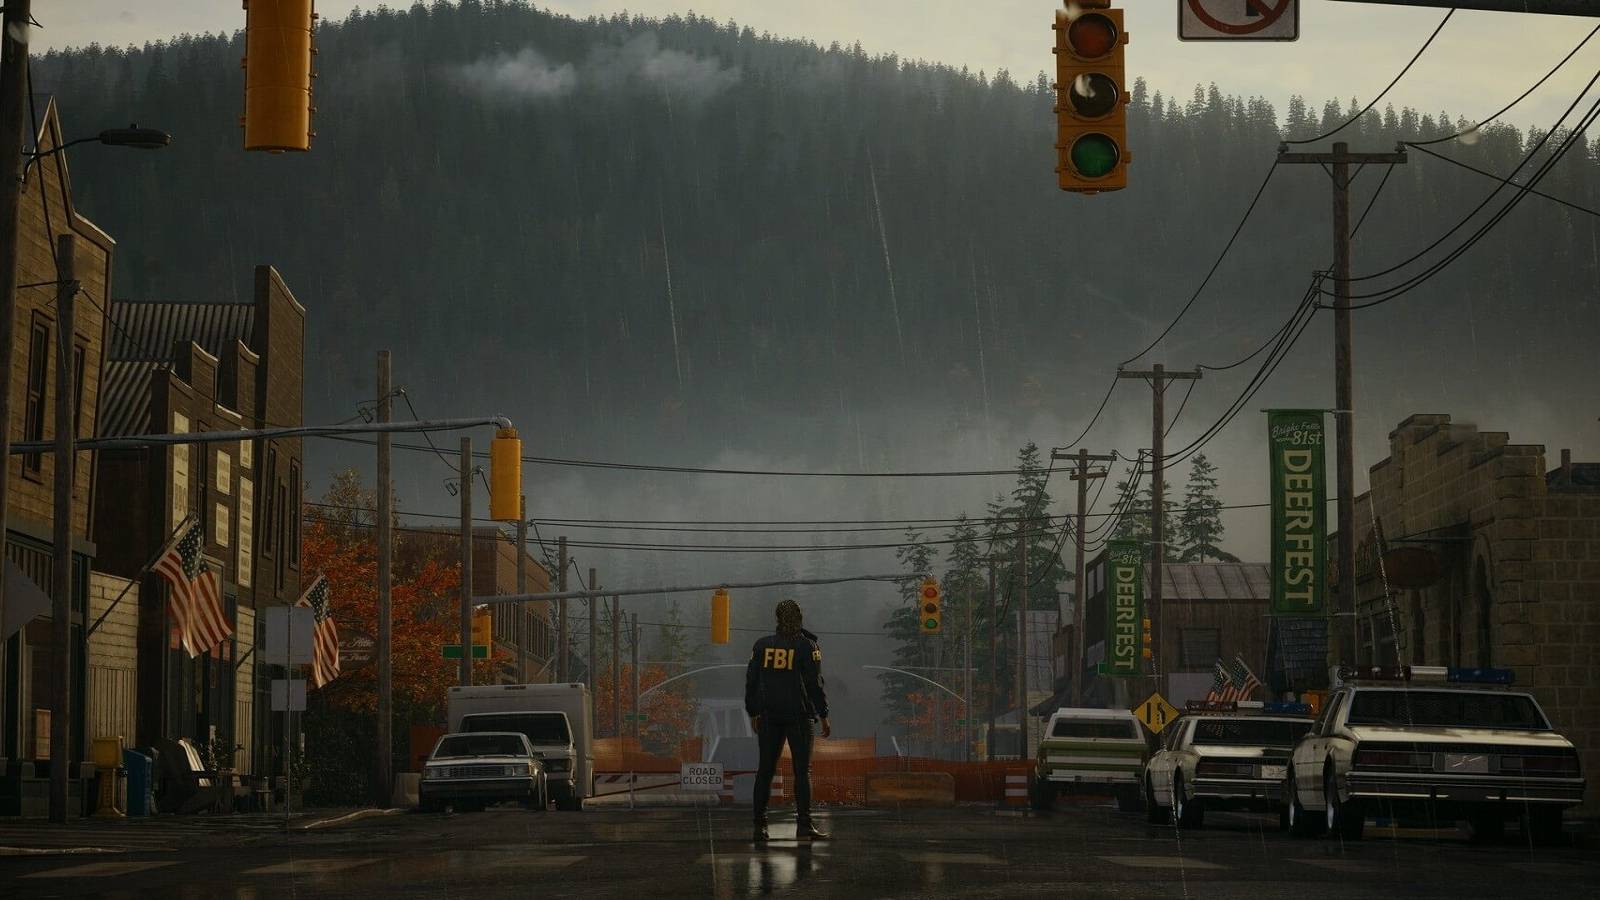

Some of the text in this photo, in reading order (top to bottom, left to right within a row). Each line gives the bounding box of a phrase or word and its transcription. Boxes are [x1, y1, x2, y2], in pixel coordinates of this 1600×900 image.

[1292, 430, 1323, 445] 81st
[1284, 449, 1314, 605] DEERFEST
[1114, 567, 1136, 670] DEERFEST
[763, 647, 796, 671] FBI
[682, 776, 722, 785] CLOSED
[688, 767, 716, 776] ROAD
